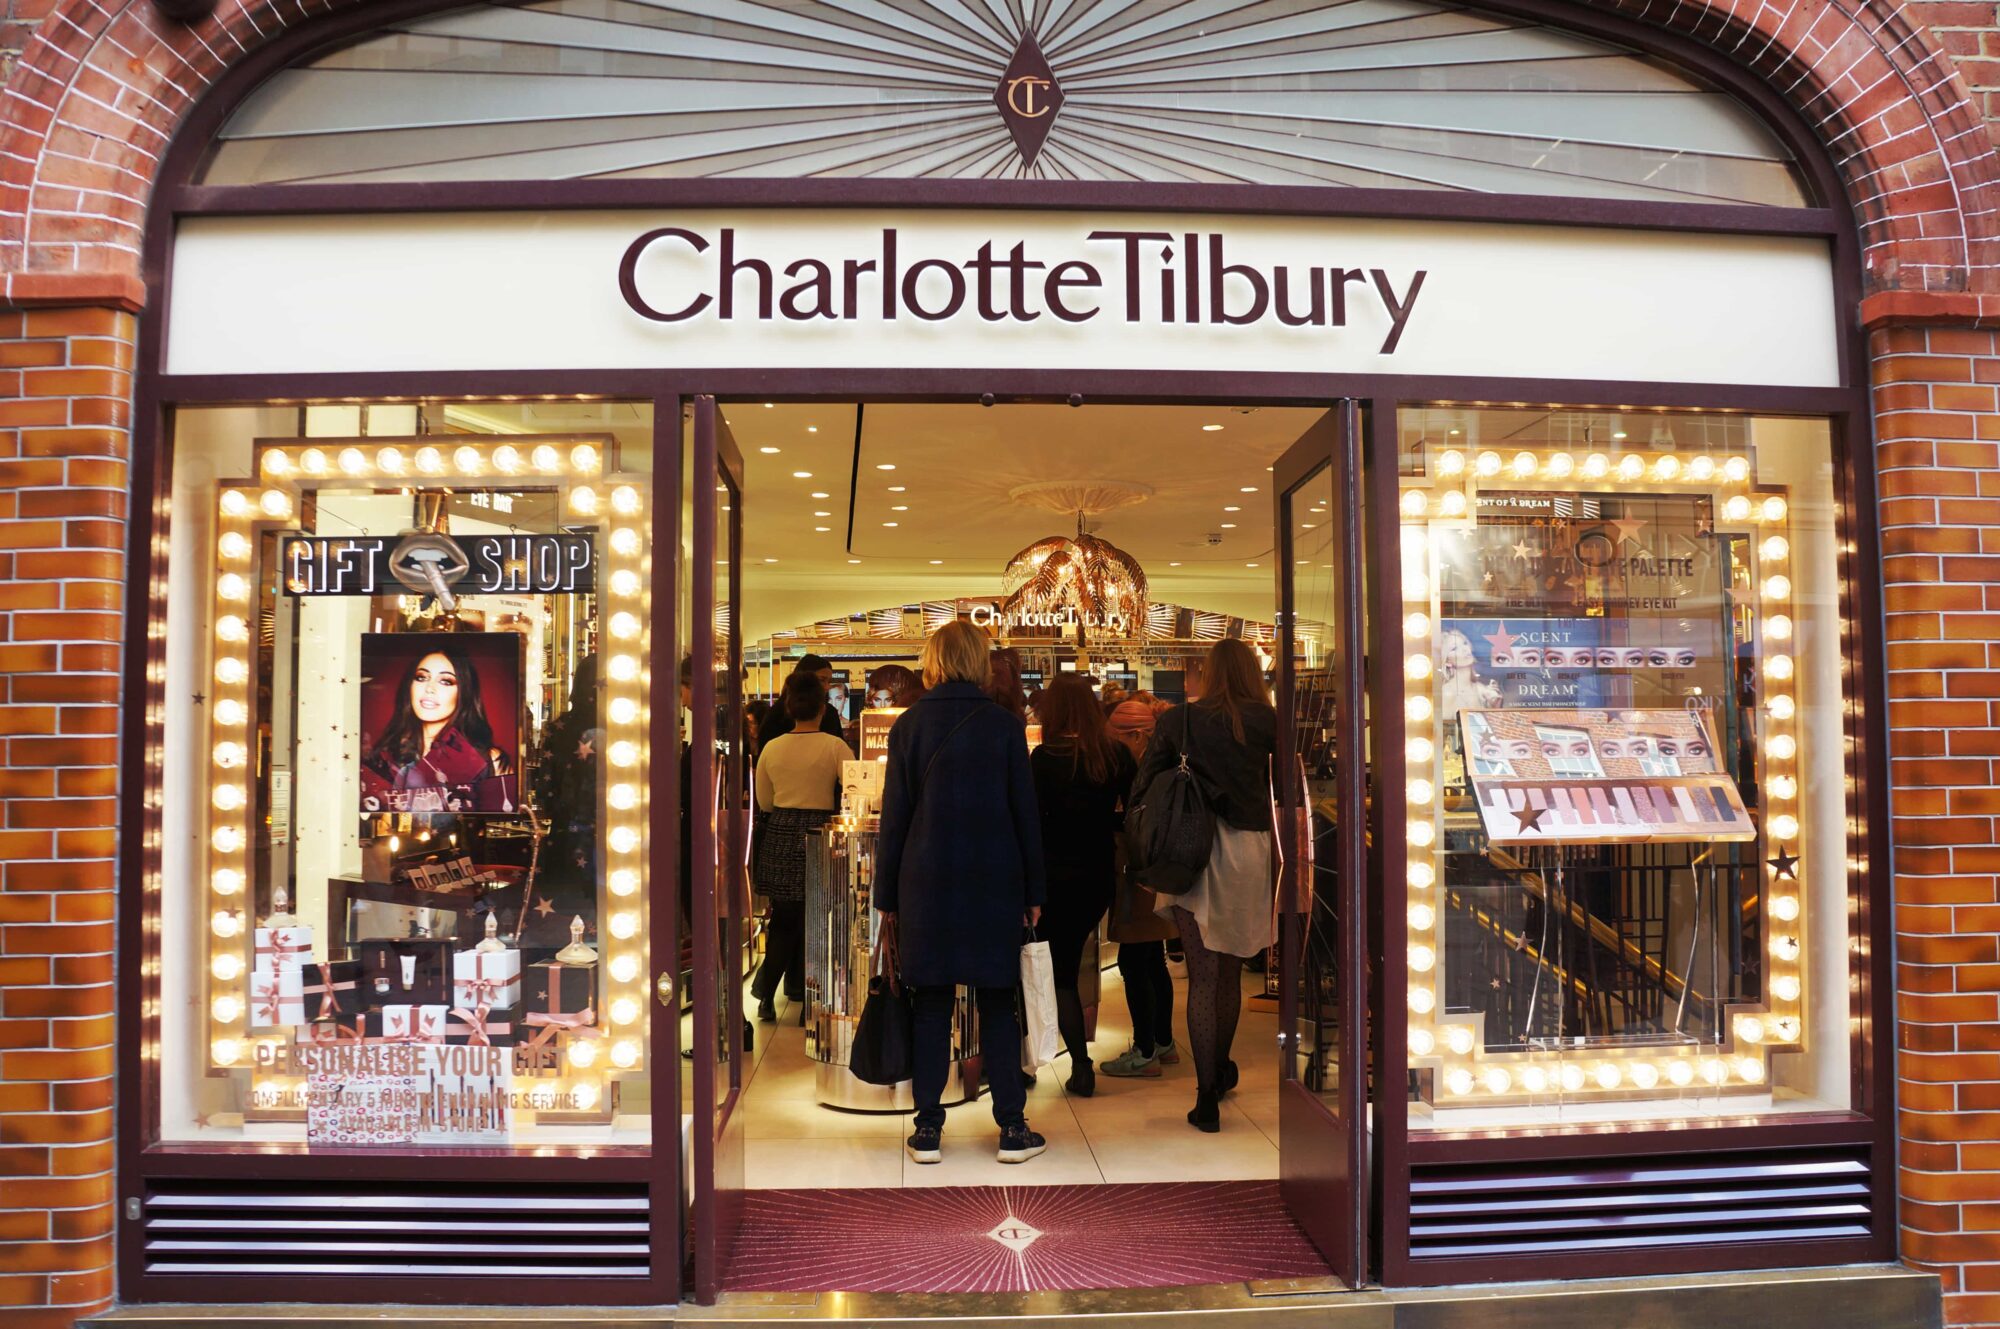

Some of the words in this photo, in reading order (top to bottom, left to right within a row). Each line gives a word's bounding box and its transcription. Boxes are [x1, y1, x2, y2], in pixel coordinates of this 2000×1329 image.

[471, 493, 489, 508] EYE
[1519, 499, 1550, 508] DREAM
[287, 540, 383, 592] GIFT
[475, 538, 590, 592] SHOP
[1631, 559, 1693, 577] PALETTE
[1603, 597, 1641, 608] MOKEY
[1643, 598, 1661, 609] EYE
[1663, 598, 1678, 609] KIT
[1519, 631, 1572, 646] SCENT
[256, 1045, 426, 1076] PERSONALISE
[435, 1046, 502, 1077] YOUR
[511, 1046, 566, 1078] GIFT
[366, 1092, 375, 1108] 5
[523, 1093, 580, 1109] SERVICE
